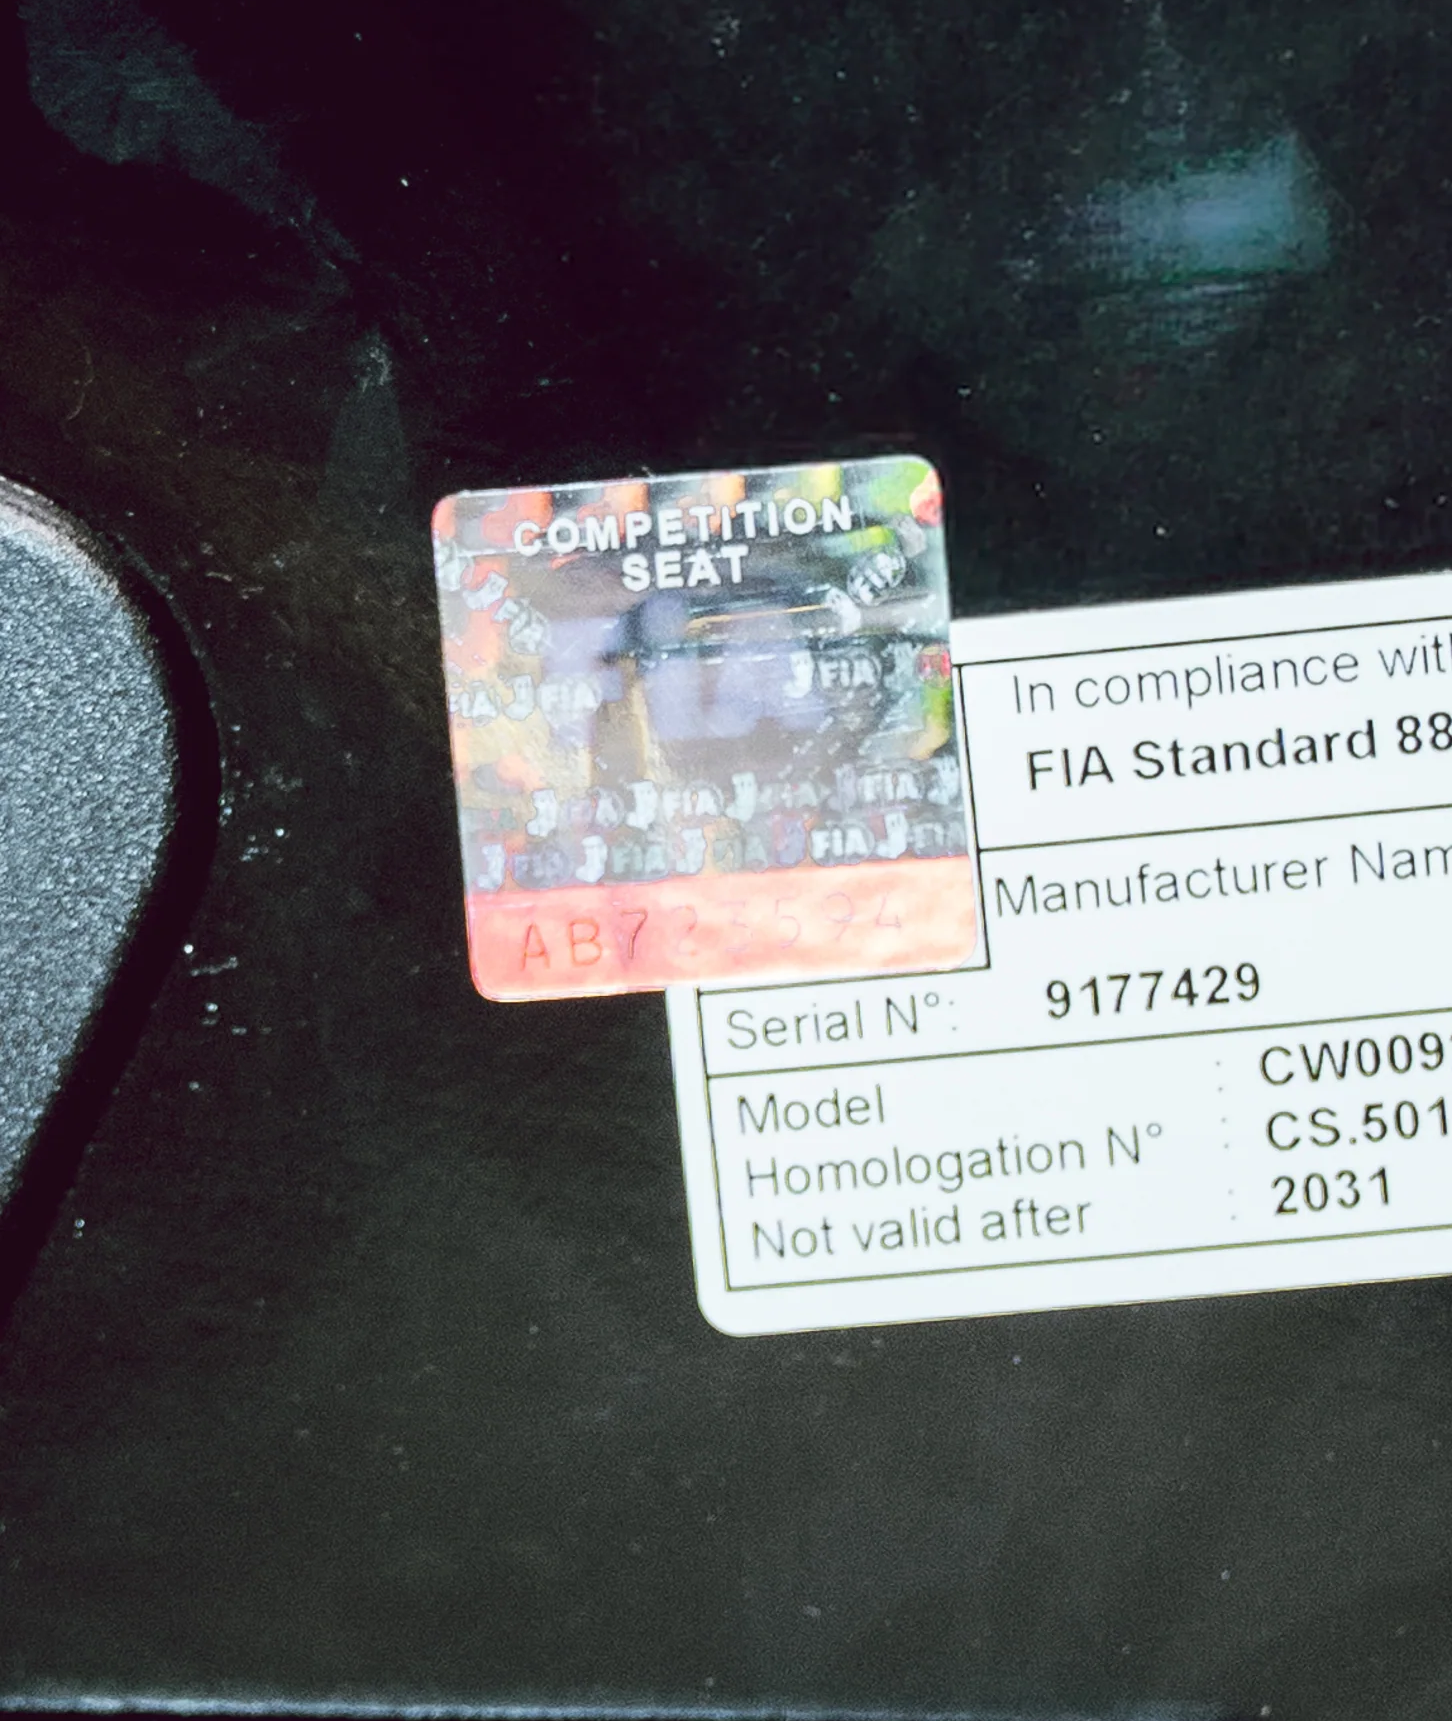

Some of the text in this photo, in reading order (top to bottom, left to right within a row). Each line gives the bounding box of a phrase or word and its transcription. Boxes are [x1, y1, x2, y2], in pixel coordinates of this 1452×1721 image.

[514, 495, 853, 557] COMPETITION
[622, 545, 750, 593] SEAT
[1012, 674, 1056, 715] In
[1074, 649, 1361, 711] compliance
[1025, 744, 1115, 792] FIA
[1131, 717, 1379, 781] Standard
[995, 853, 1330, 918] Manufacturer
[726, 998, 864, 1051] Serial
[1044, 961, 1262, 1021] 9177429
[736, 1082, 886, 1135] Model
[745, 1136, 1087, 1198] Homologation
[751, 1216, 835, 1261] Not
[851, 1203, 963, 1253] valid
[980, 1197, 1093, 1243] after
[1270, 1165, 1391, 1217] 2031
